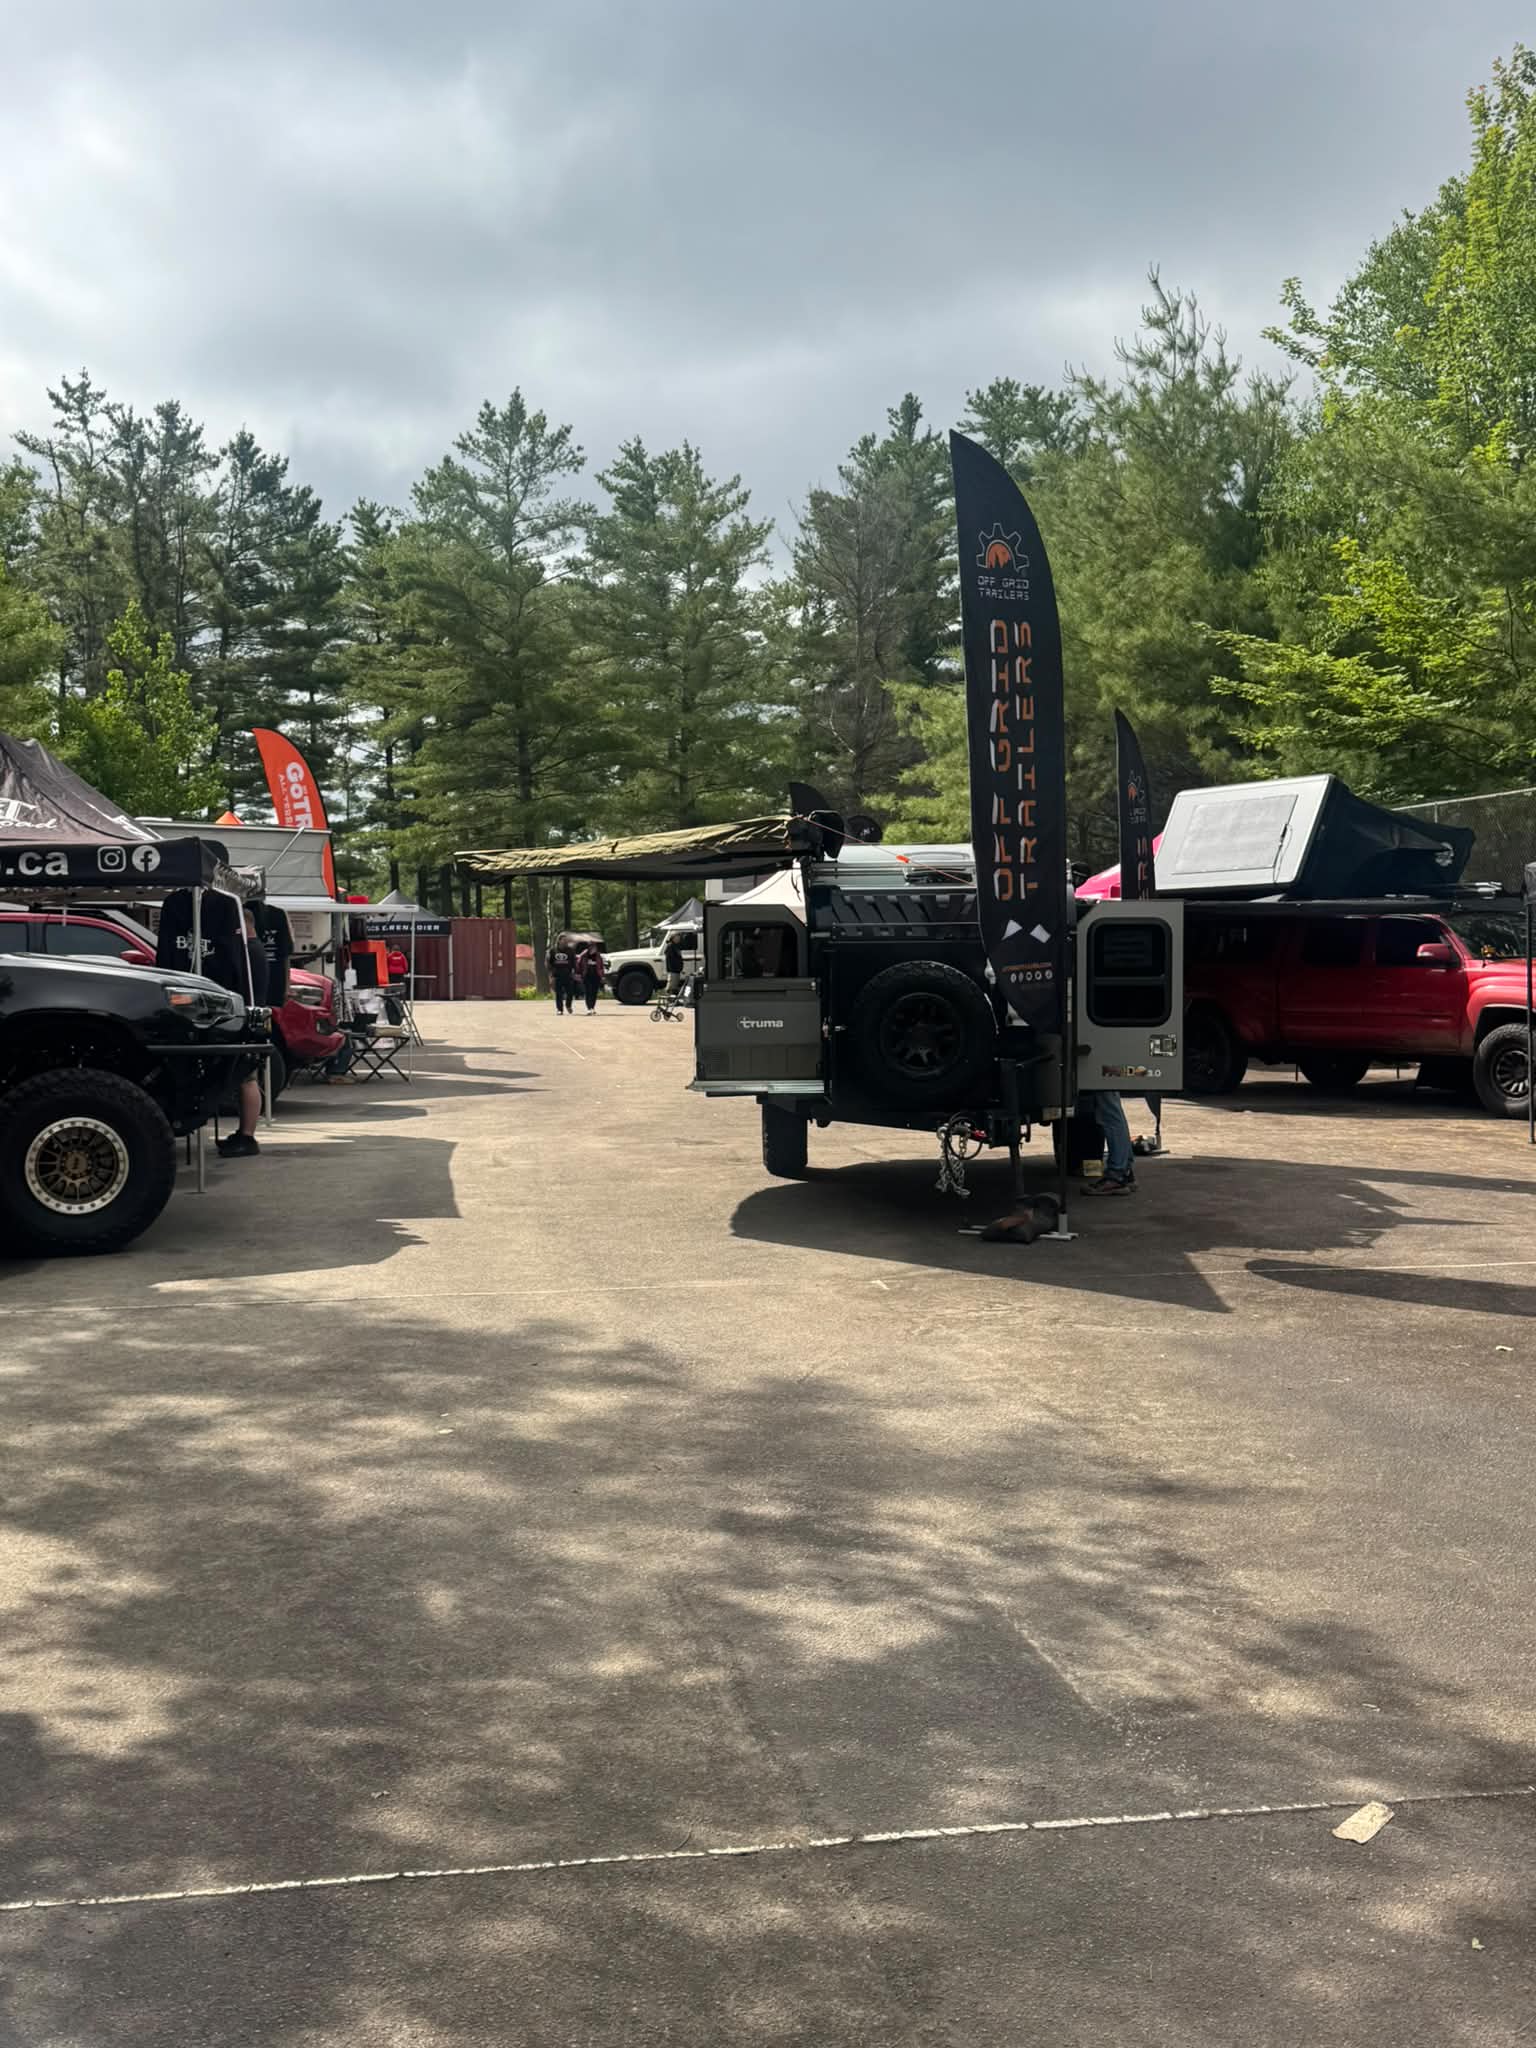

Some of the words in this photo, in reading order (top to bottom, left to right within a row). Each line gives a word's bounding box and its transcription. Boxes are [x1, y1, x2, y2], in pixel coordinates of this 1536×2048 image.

[977, 575, 995, 586] OFF
[1002, 578, 1029, 589] GRID
[978, 587, 1029, 600] TRAILERS
[989, 619, 1012, 773] GRID
[1014, 621, 1039, 900] TRAILERS
[992, 791, 1013, 900] OFF
[0, 851, 69, 876] .ca
[739, 1017, 784, 1029] truma
